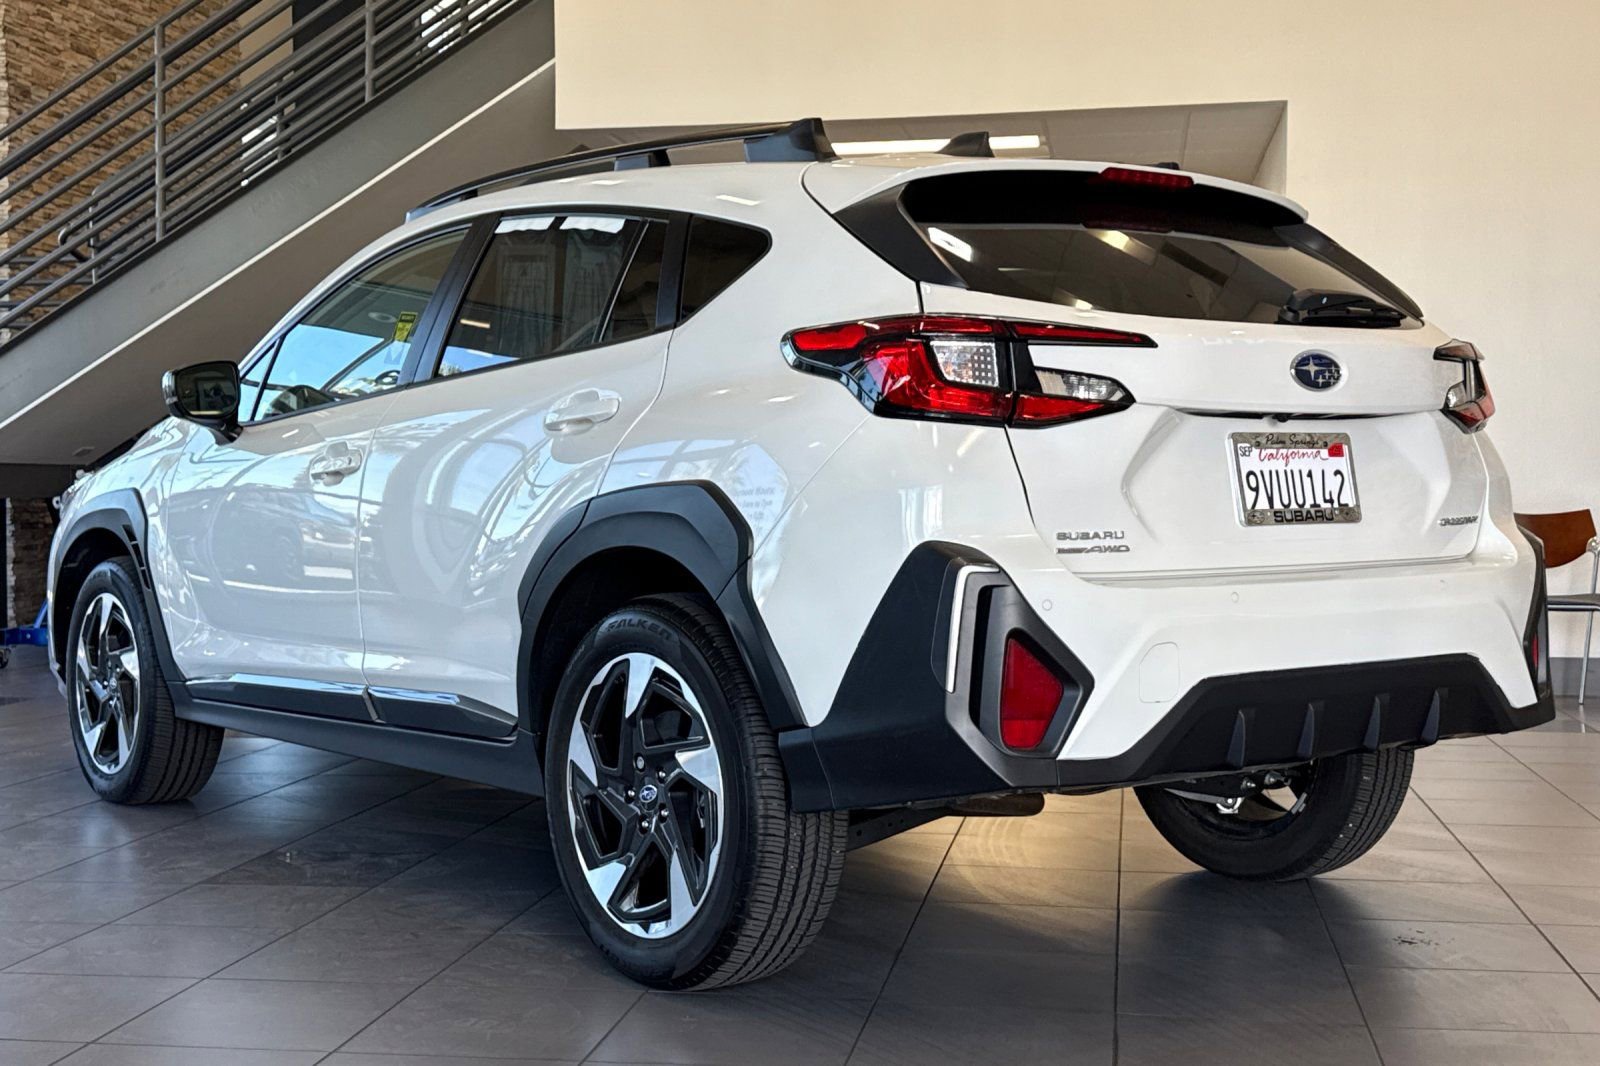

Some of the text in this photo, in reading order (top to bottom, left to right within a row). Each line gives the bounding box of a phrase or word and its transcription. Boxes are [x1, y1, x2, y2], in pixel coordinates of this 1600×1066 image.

[1265, 433, 1319, 447] Palm Springs
[1239, 445, 1253, 457] SEP
[1258, 448, 1329, 467] California
[1245, 469, 1350, 510] 9VUU142
[1273, 510, 1335, 523] SUBARU
[1056, 530, 1125, 541] SUBARU
[1085, 545, 1130, 553] AWD
[606, 618, 673, 640] FALKEN
